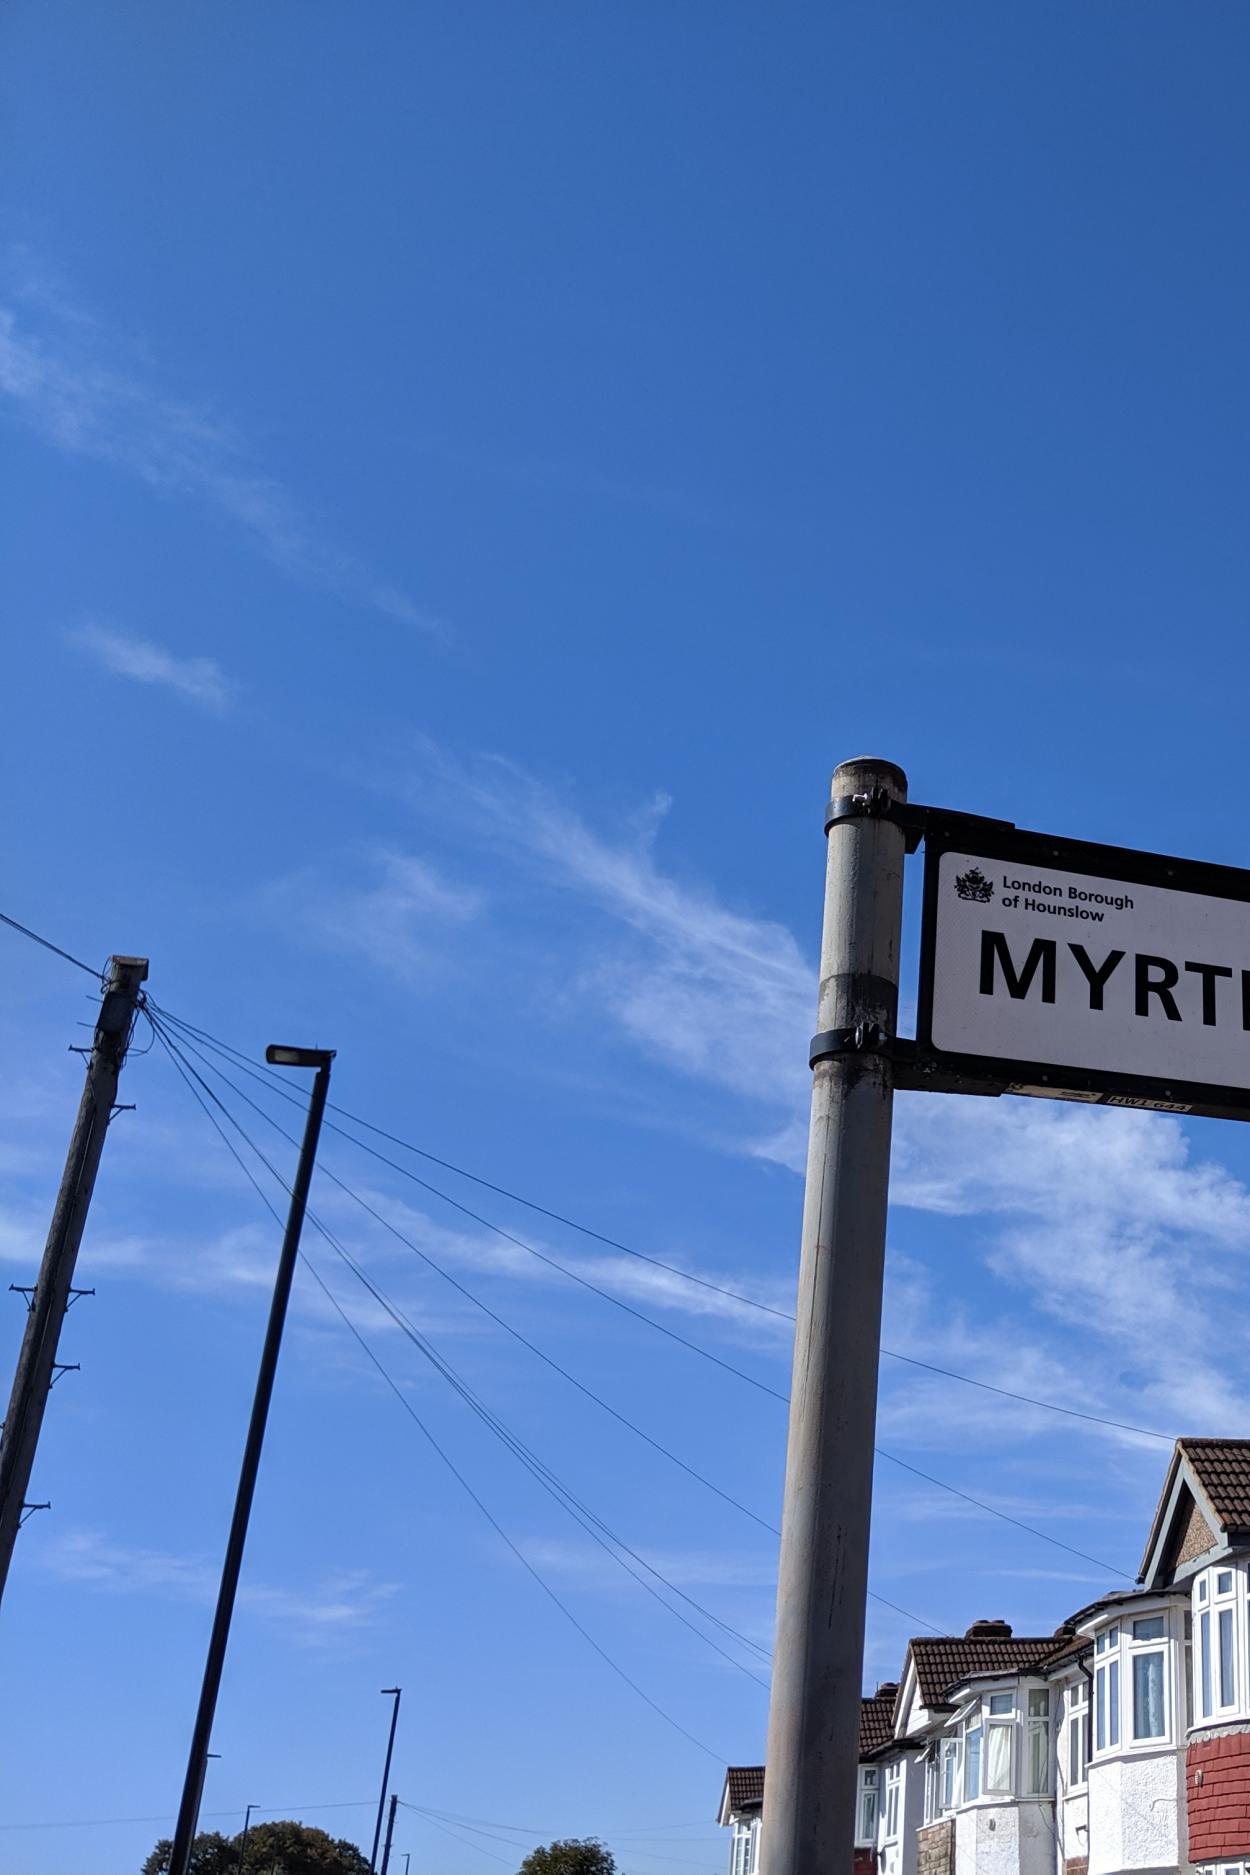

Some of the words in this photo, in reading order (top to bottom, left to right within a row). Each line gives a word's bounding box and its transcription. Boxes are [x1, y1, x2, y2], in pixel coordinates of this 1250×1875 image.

[1002, 874, 1063, 898] London
[1067, 886, 1134, 910] Borough
[1001, 894, 1020, 909] of
[1024, 897, 1105, 923] Hounslow
